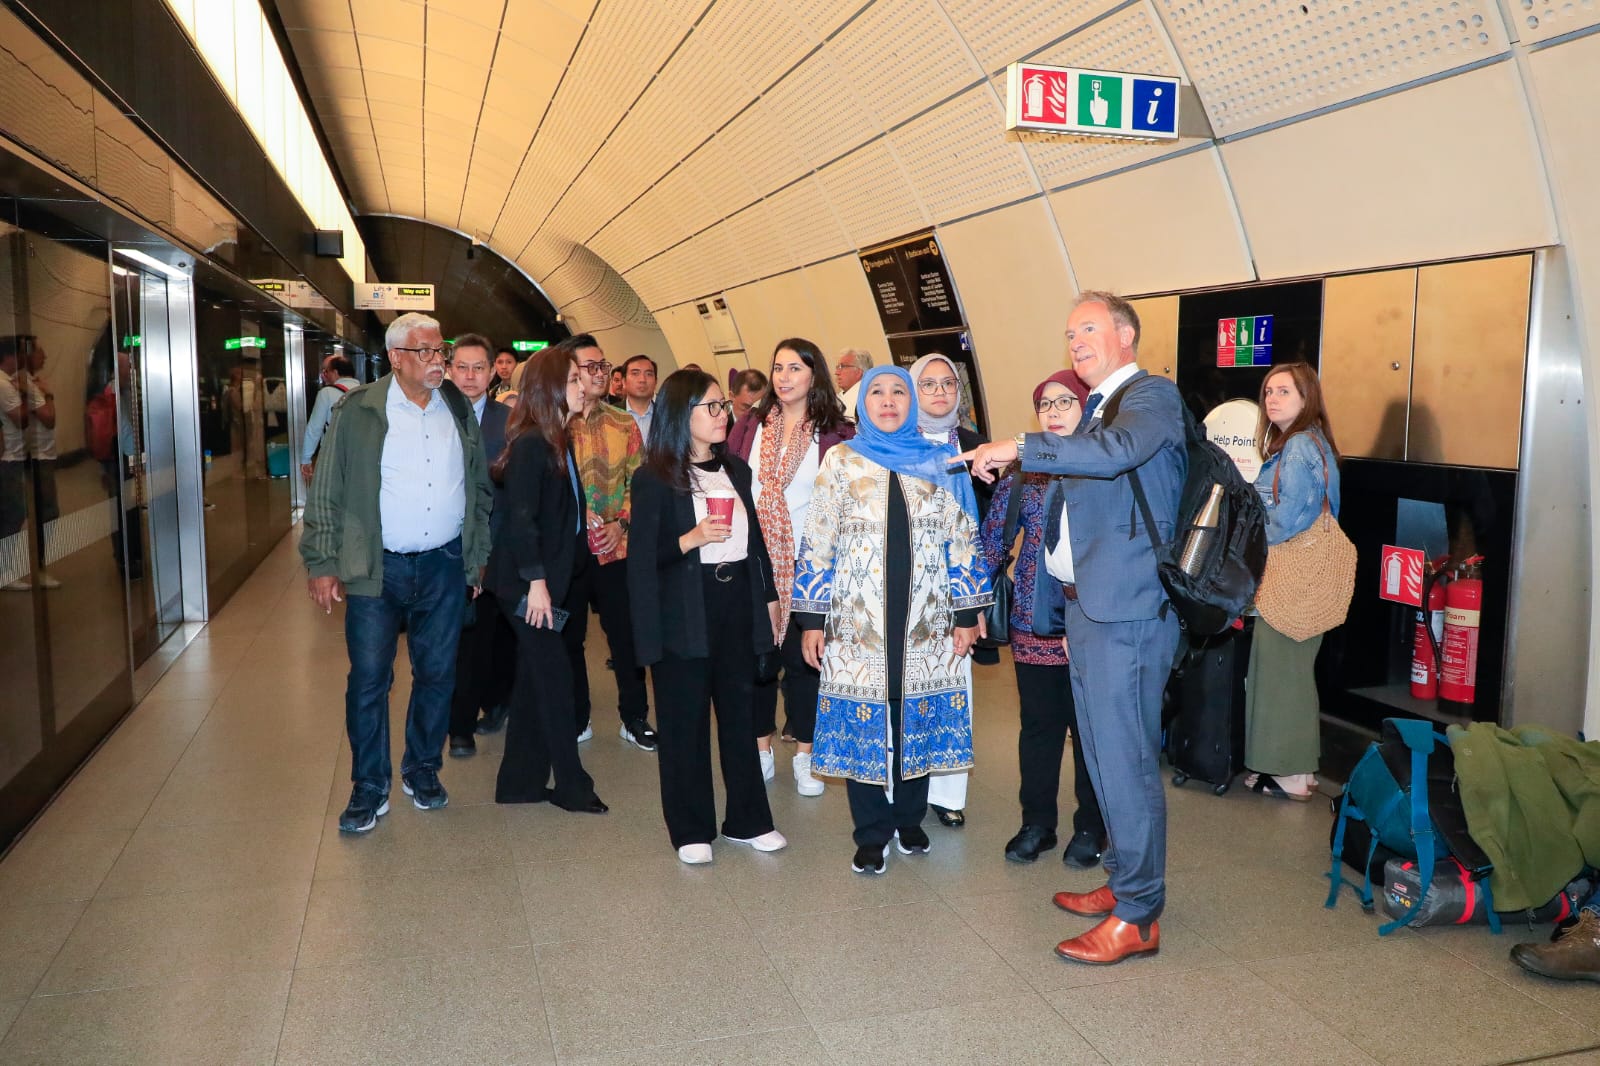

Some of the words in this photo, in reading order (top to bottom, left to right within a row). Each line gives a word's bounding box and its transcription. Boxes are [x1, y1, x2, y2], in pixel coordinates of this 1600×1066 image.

[1213, 434, 1231, 447] Help
[1232, 435, 1257, 447] Point
[1446, 611, 1466, 621] Foam
